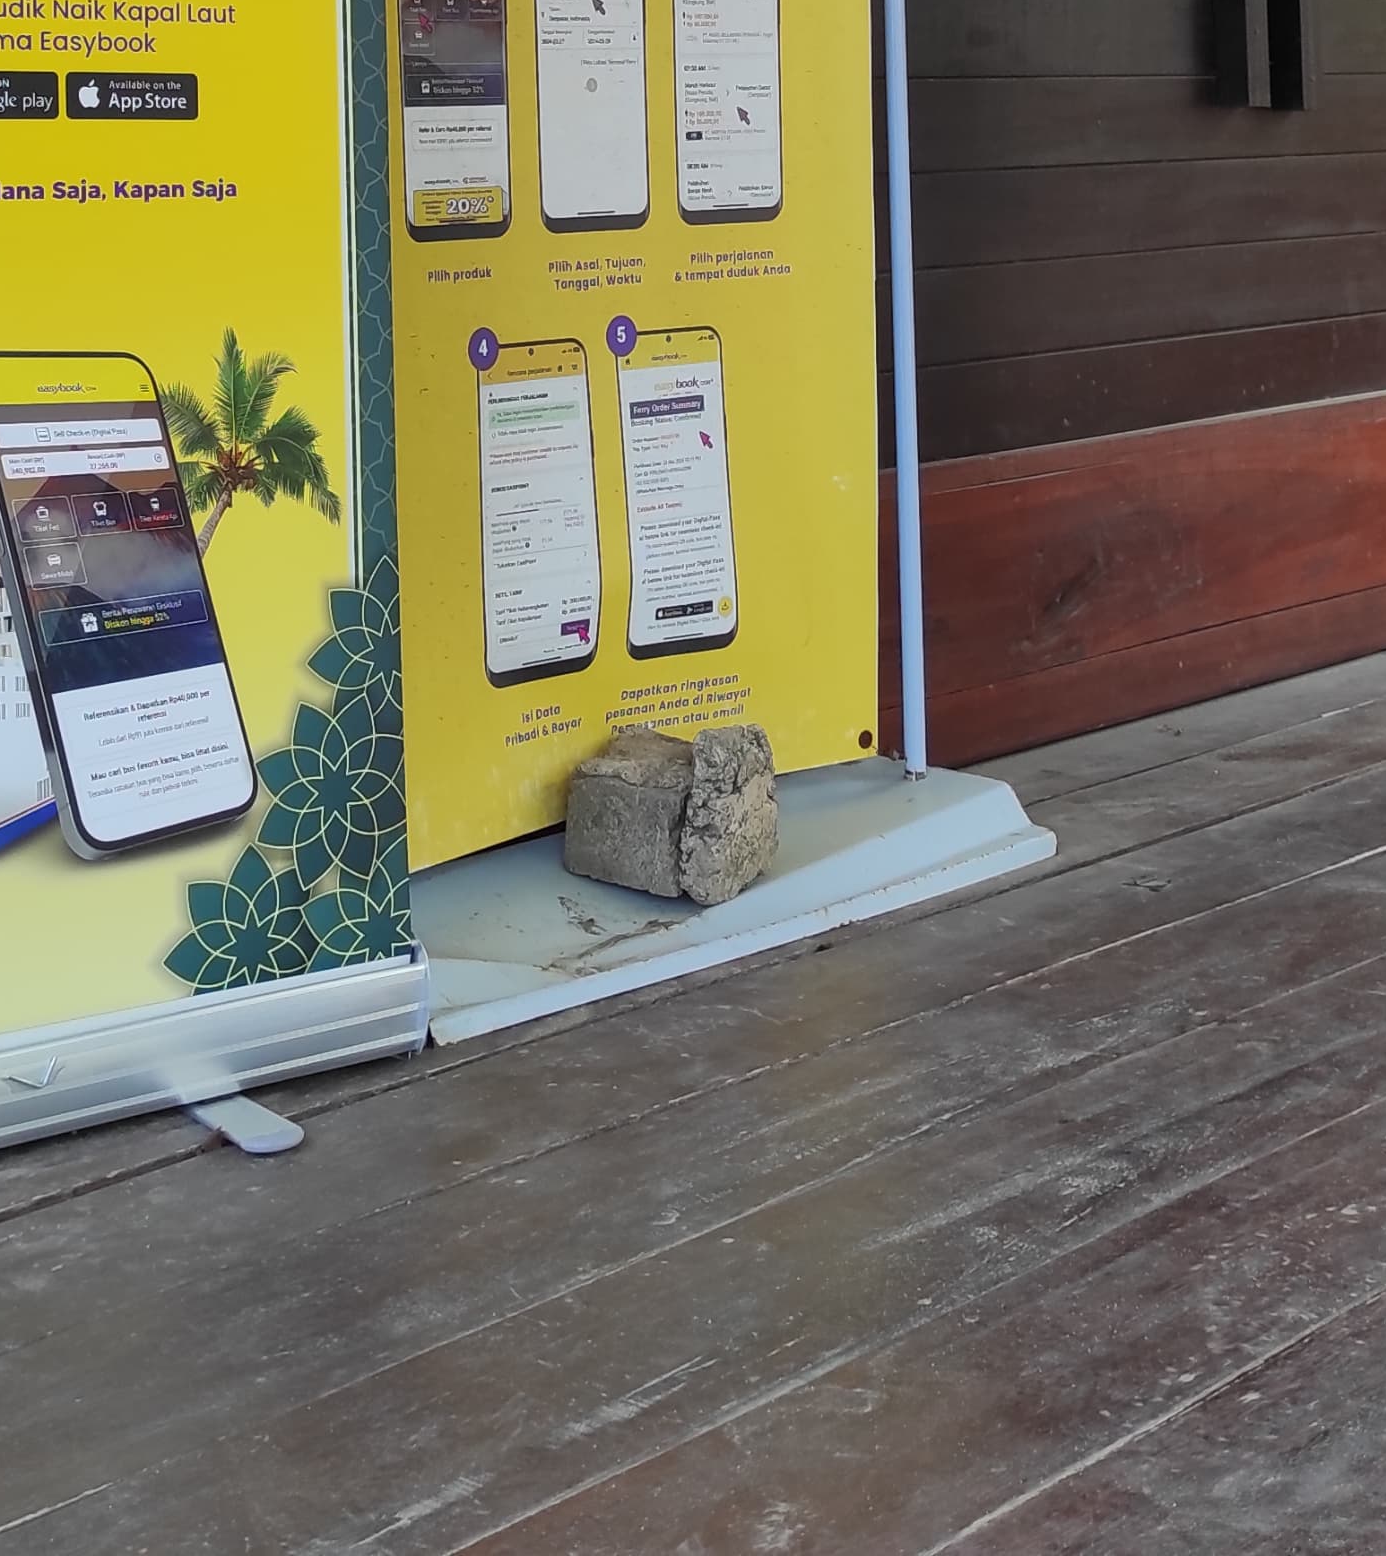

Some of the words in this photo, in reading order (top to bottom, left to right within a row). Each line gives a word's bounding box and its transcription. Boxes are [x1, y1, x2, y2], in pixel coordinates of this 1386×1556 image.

[53, 0, 107, 21] Naik
[112, 0, 181, 28] Kapal
[187, 3, 237, 24] Laut
[40, 30, 157, 58] Easybook
[108, 80, 151, 91] Available
[152, 83, 165, 91] on
[166, 80, 182, 91] the
[22, 92, 54, 113] play
[108, 94, 143, 113] App
[145, 94, 187, 110] Store
[51, 180, 108, 207] Saja,
[113, 178, 185, 206] Kapan
[191, 178, 238, 204] Saja
[446, 197, 489, 215] 20%
[548, 260, 573, 274] Pilih
[575, 258, 603, 273] Asal,
[604, 256, 646, 272] Tujuan,
[690, 251, 714, 265] Pilih
[715, 248, 774, 266] perjalanan
[427, 269, 451, 283] Pilih
[452, 266, 493, 283] produk
[554, 276, 603, 292] Tanggal,
[606, 273, 642, 287] Waktu
[674, 271, 683, 282] &
[685, 267, 724, 283] tempat
[726, 265, 761, 279] duduk
[762, 263, 791, 276] Anda
[616, 325, 627, 343] 5
[477, 338, 489, 357] 4
[651, 401, 671, 413] Order
[671, 399, 701, 412] Summary
[621, 683, 678, 702] Dapatkan
[680, 674, 739, 692] ringkasan
[659, 698, 690, 711] Anda
[692, 694, 704, 706] di
[706, 687, 752, 705] Riwayat
[521, 711, 534, 723] Isi
[536, 704, 561, 720] Data
[682, 710, 710, 724] atau
[712, 704, 745, 718] email
[504, 729, 540, 747] Pribadi
[541, 724, 550, 736] &
[551, 717, 583, 735] Bayar
